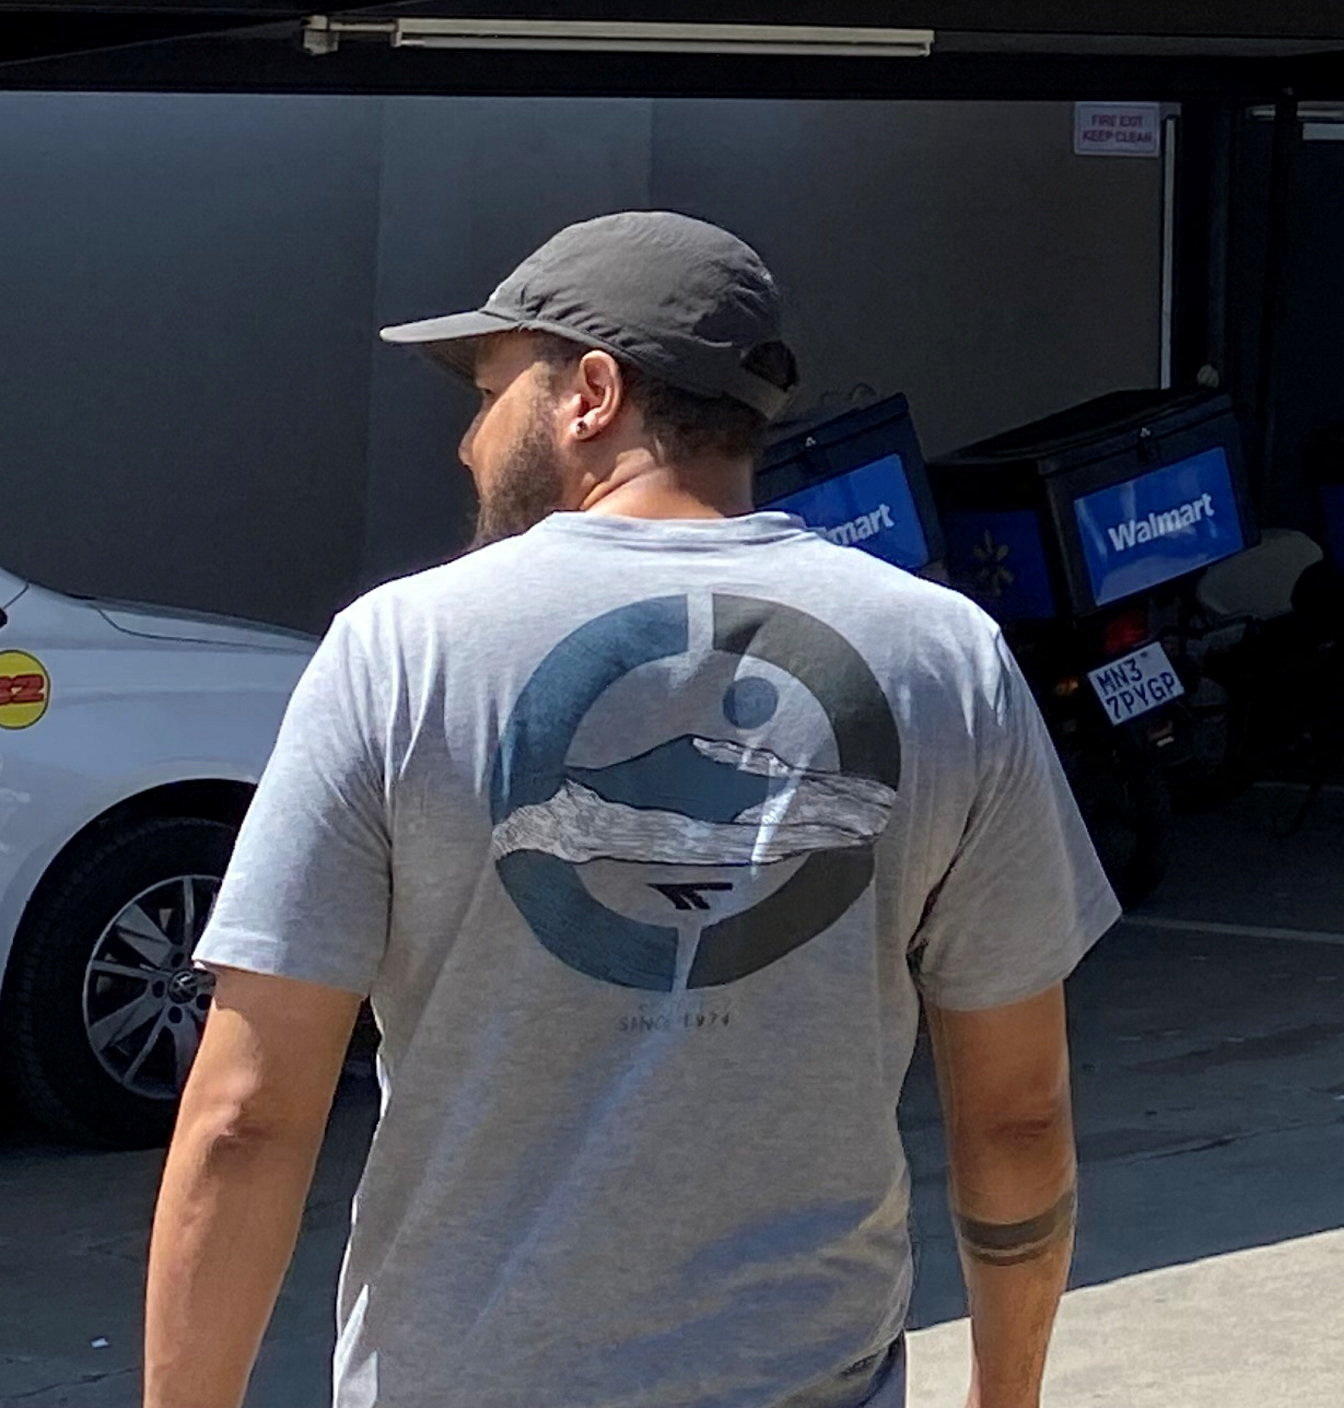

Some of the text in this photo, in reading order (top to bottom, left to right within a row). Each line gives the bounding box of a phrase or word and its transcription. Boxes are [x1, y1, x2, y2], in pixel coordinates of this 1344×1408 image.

[826, 503, 895, 545] mart
[1107, 493, 1215, 551] Walmart
[1096, 658, 1143, 696] MN3
